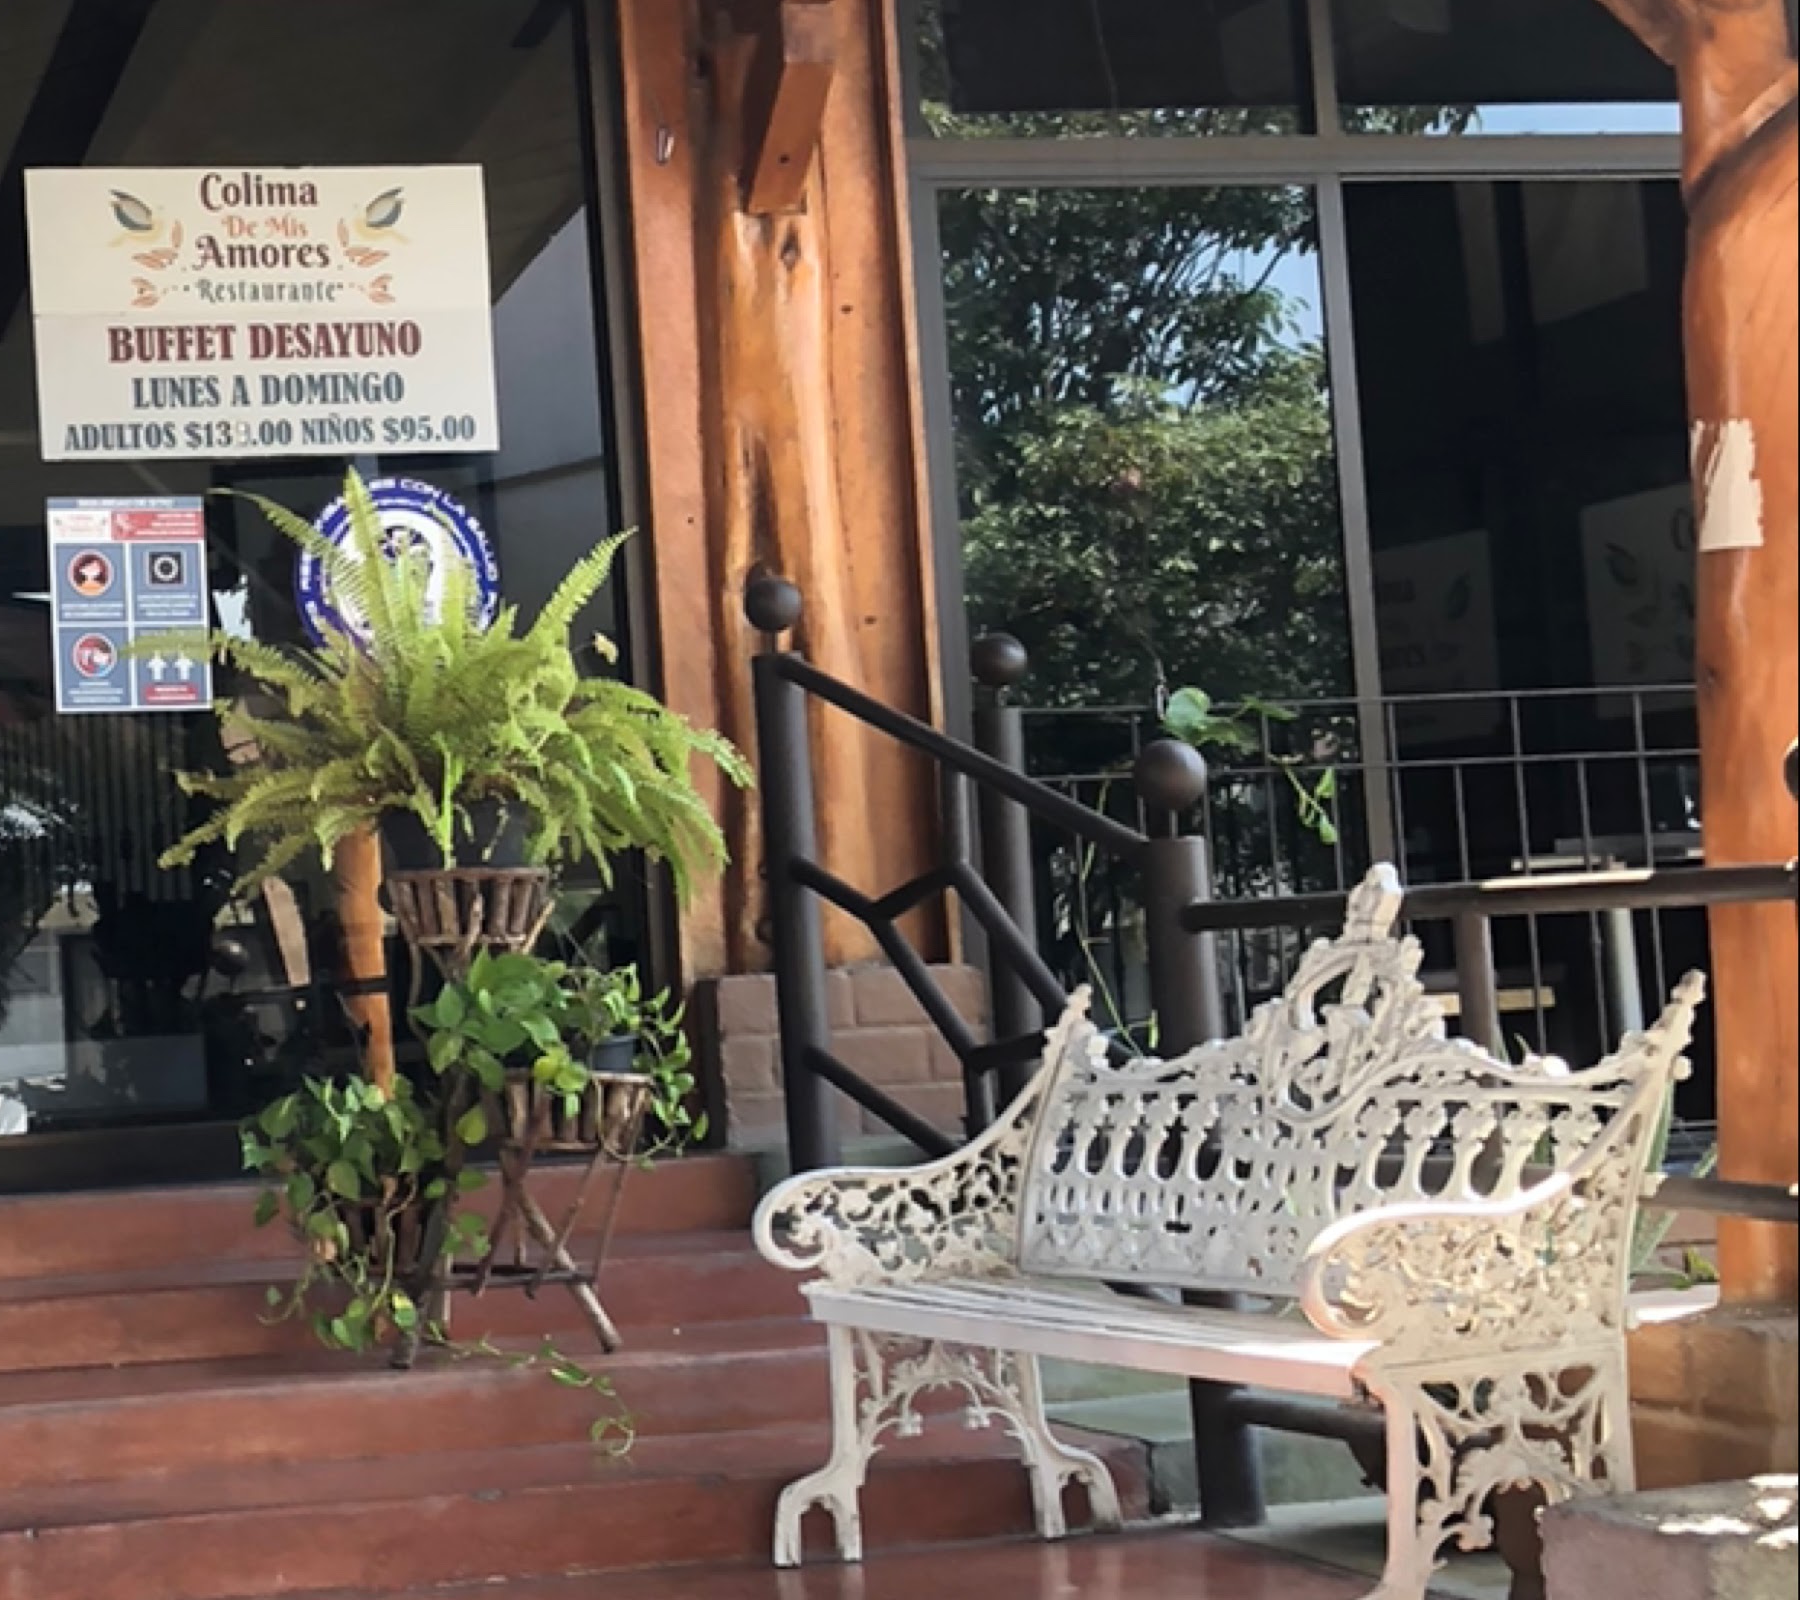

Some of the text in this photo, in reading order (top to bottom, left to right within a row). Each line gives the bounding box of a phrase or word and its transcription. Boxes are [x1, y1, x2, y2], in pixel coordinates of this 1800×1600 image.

[199, 172, 319, 211] Colima
[221, 214, 310, 238] De Mis
[193, 234, 331, 271] Amores
[194, 277, 337, 303] Restaurante
[108, 319, 422, 363] BUFFET DESAYUNO
[132, 369, 406, 411] LUNES A DOMINGO
[64, 421, 177, 453] ADULTOS
[301, 409, 378, 446] NIÑOS
[383, 413, 477, 444] $95.00
